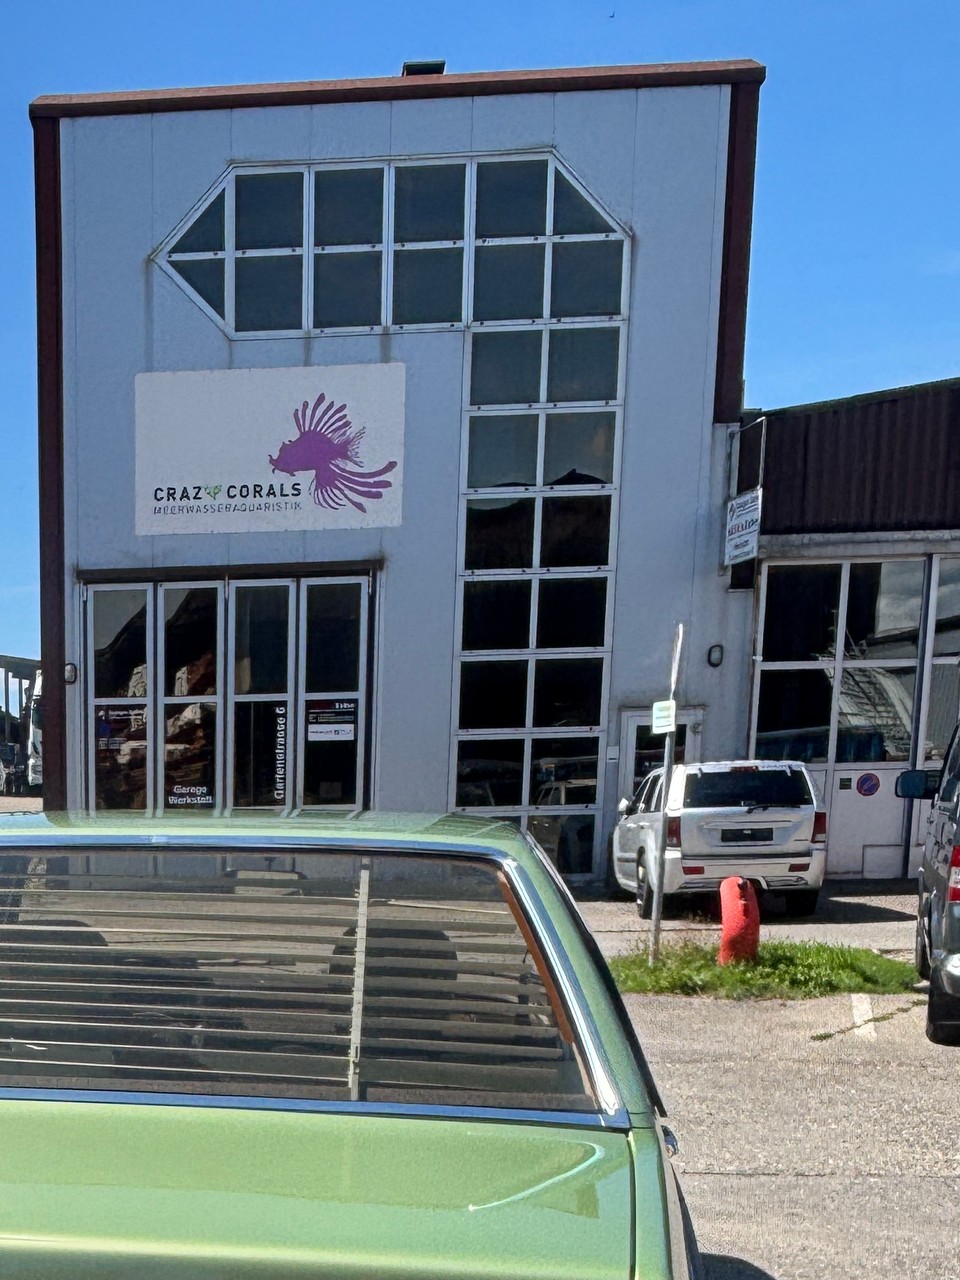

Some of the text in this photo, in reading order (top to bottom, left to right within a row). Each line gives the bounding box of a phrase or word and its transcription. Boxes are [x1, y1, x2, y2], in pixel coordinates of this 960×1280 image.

[226, 482, 302, 500] CORALS
[153, 501, 302, 515] MEERWASSERAQUARISTIK
[173, 785, 207, 796] Garage
